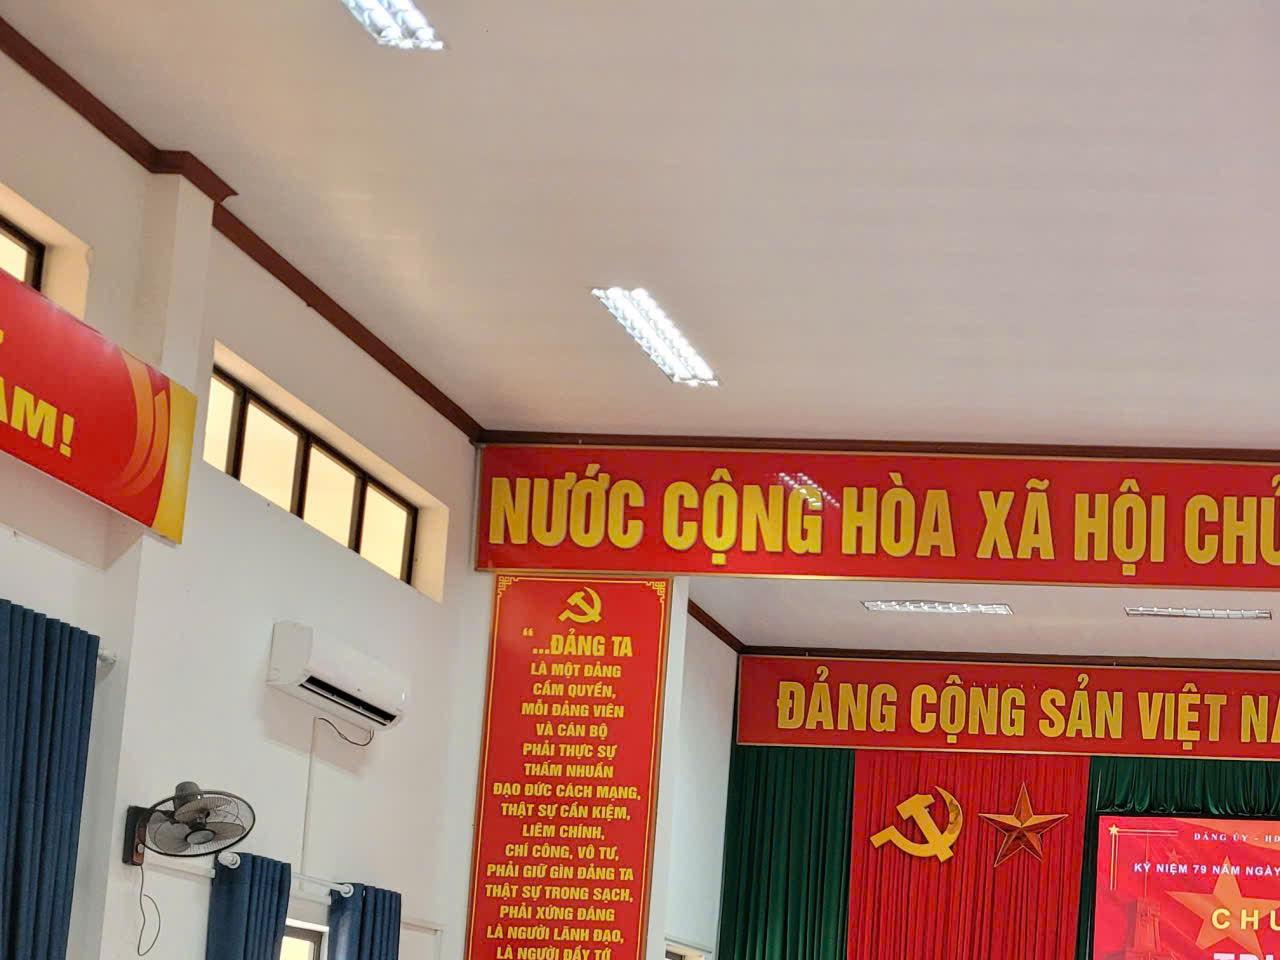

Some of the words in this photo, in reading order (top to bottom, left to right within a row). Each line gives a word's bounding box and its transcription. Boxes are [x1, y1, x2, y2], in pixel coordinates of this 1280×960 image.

[0, 376, 75, 458] M!
[489, 465, 644, 549] NƯỚC
[662, 468, 823, 565] CỘNG
[842, 471, 956, 560] HÒA
[976, 478, 1055, 562] XÃ
[1073, 478, 1167, 574] HỘI
[612, 636, 632, 657] TA
[552, 662, 581, 678] MỘT
[776, 667, 897, 734] ĐẢNG
[915, 675, 1026, 744] CỘNG
[1037, 672, 1124, 740] SẢN
[1138, 682, 1226, 750] VIỆT
[536, 722, 553, 736] VÀ
[590, 723, 608, 740] BỘ
[494, 783, 521, 798] ĐẠO
[525, 782, 552, 796] ĐỨC
[556, 783, 592, 798] CÁCH
[523, 823, 555, 837] LIÊM
[532, 843, 573, 859] CÔNG,
[578, 844, 595, 859] VÔ
[619, 868, 634, 880] TA
[1156, 863, 1188, 875] NIỆM
[1193, 864, 1206, 874] 79
[1245, 864, 1280, 876] NGÀY
[486, 883, 519, 900] THẬT
[544, 887, 589, 900] TRONG
